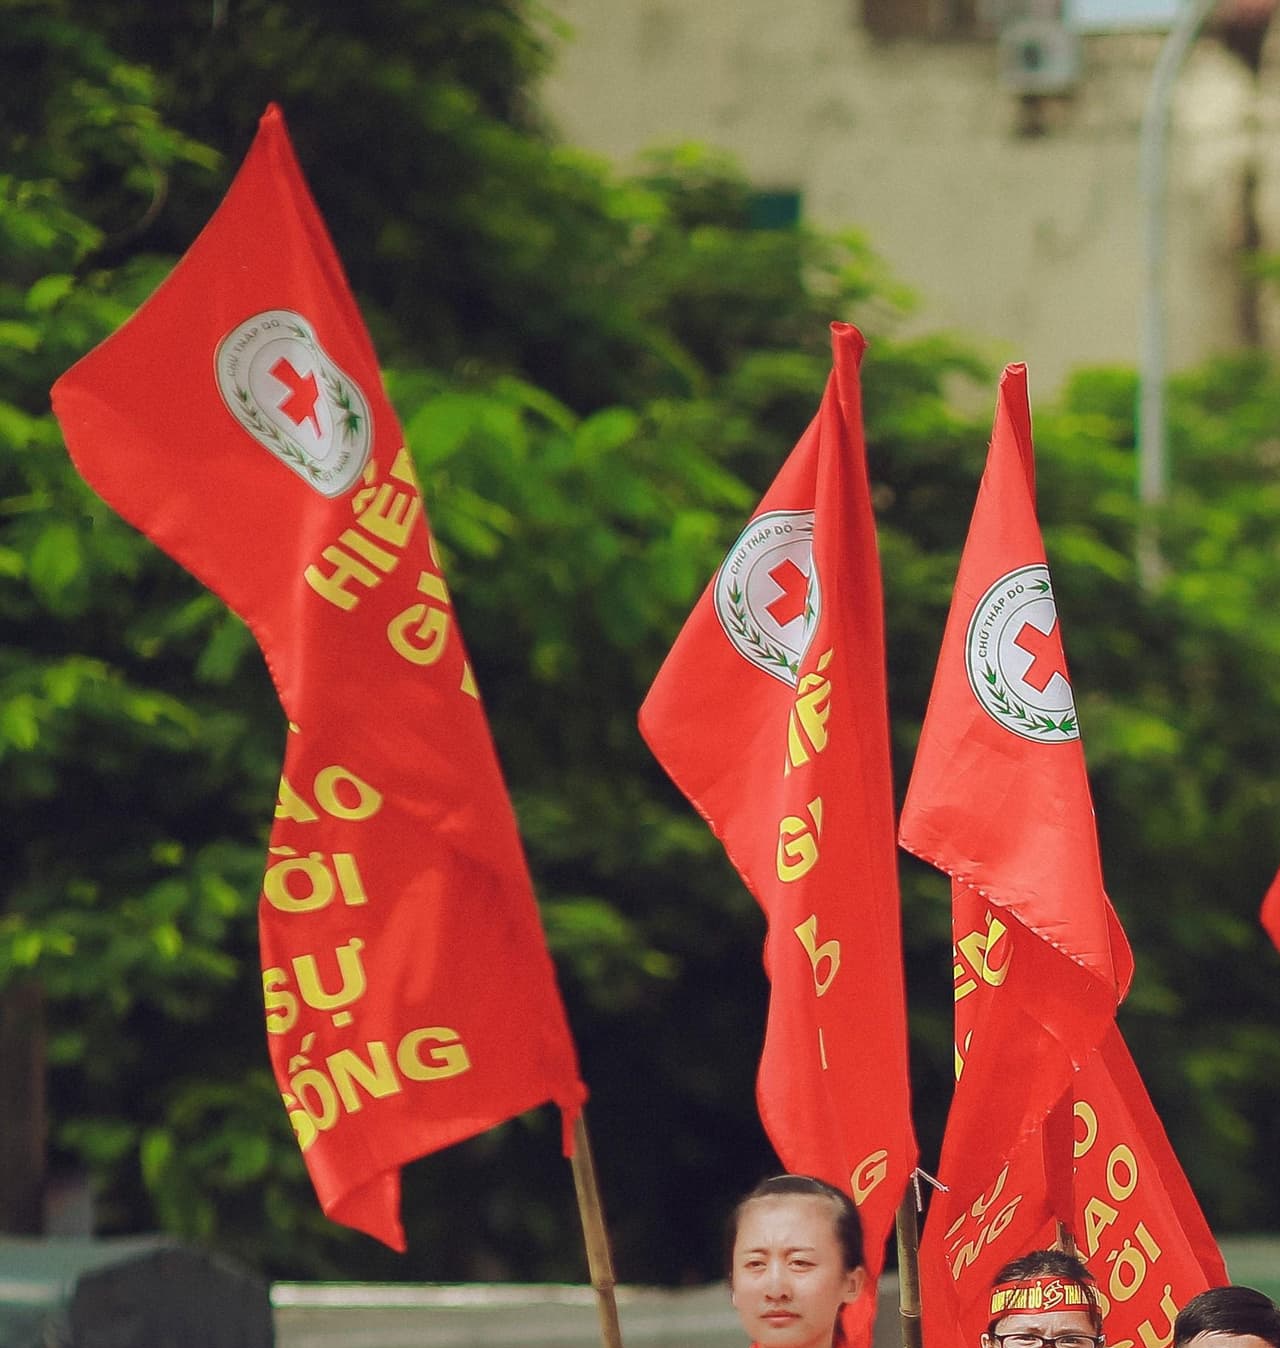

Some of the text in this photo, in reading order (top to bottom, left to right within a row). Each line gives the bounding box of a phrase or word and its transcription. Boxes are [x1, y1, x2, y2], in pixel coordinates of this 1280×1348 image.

[984, 596, 1007, 626] THẬP
[274, 764, 383, 824] AO
[263, 846, 369, 913] ỜI
[1062, 1143, 1138, 1264] AO
